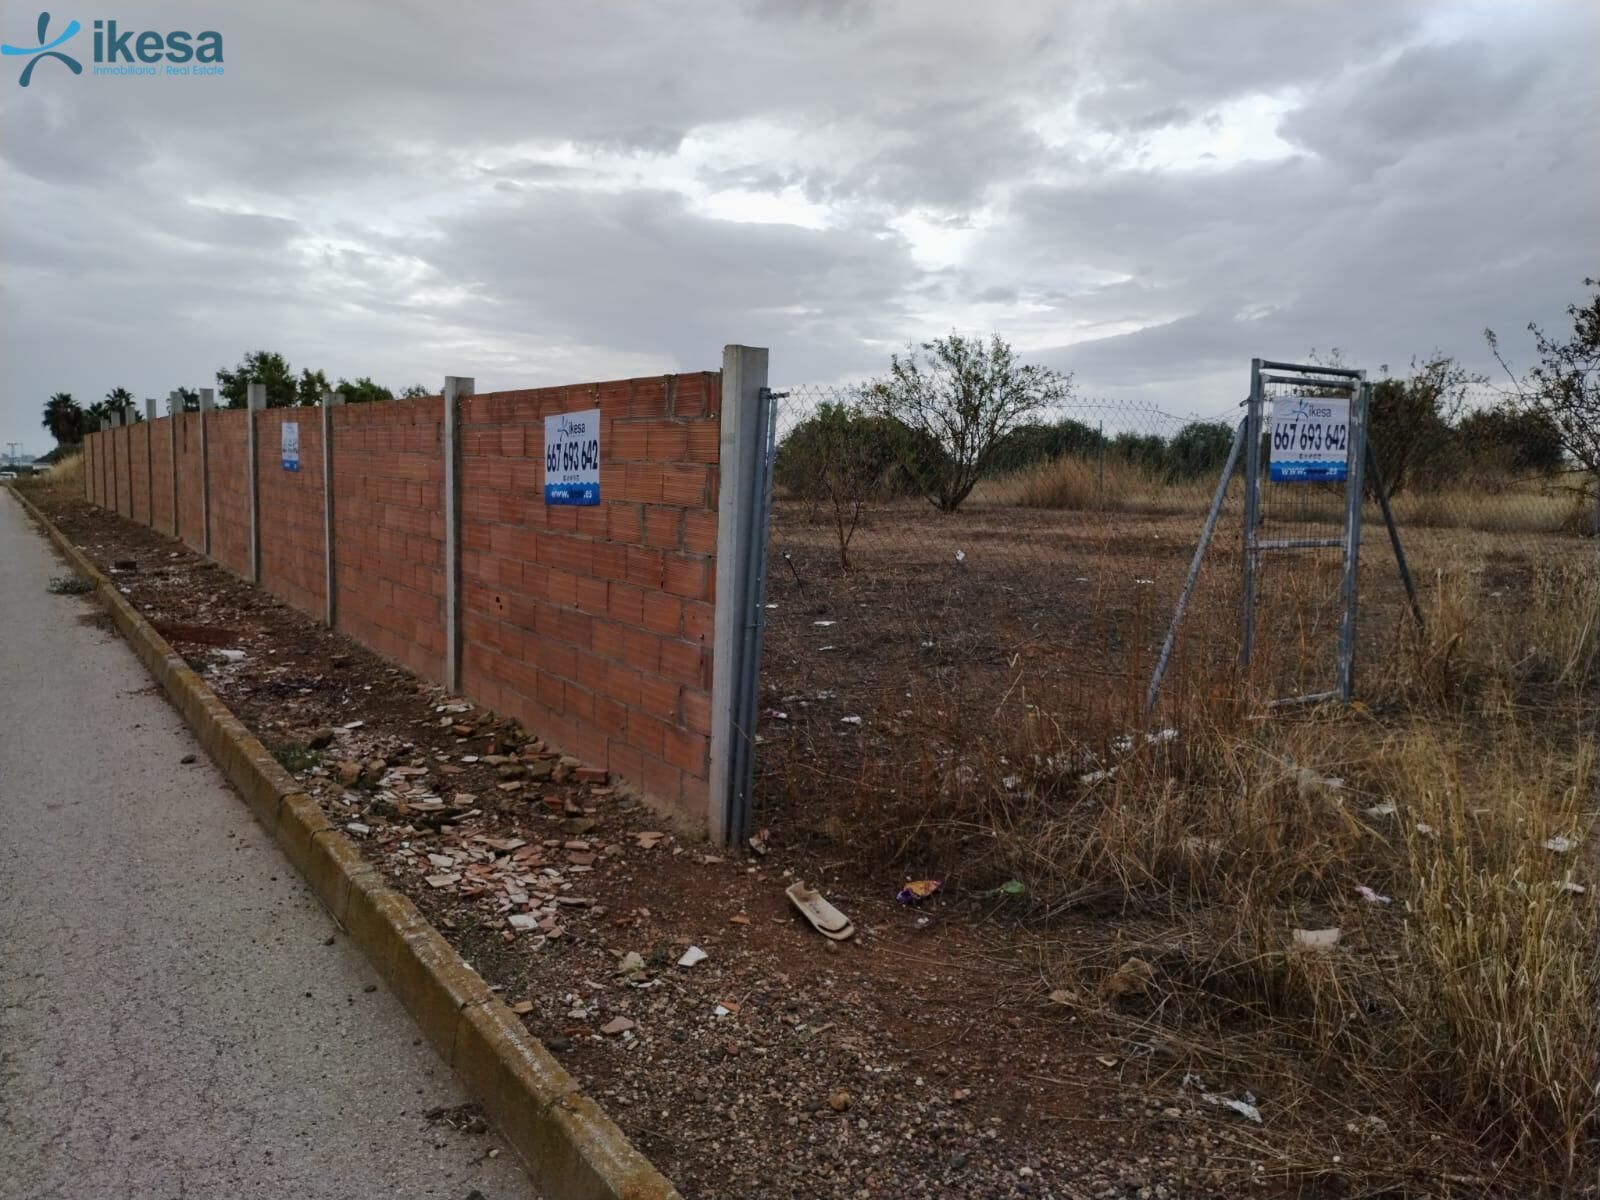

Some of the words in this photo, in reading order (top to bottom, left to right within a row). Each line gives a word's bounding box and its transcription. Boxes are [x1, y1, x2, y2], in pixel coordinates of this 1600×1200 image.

[1308, 404, 1332, 418] ikesa
[568, 420, 586, 434] ikesa
[1274, 424, 1297, 450] 667
[1300, 424, 1322, 450] 693
[1325, 424, 1346, 450] 642
[547, 443, 561, 473] 667
[563, 441, 579, 472] 693
[581, 439, 598, 471] 642
[551, 489, 593, 499] www..es
